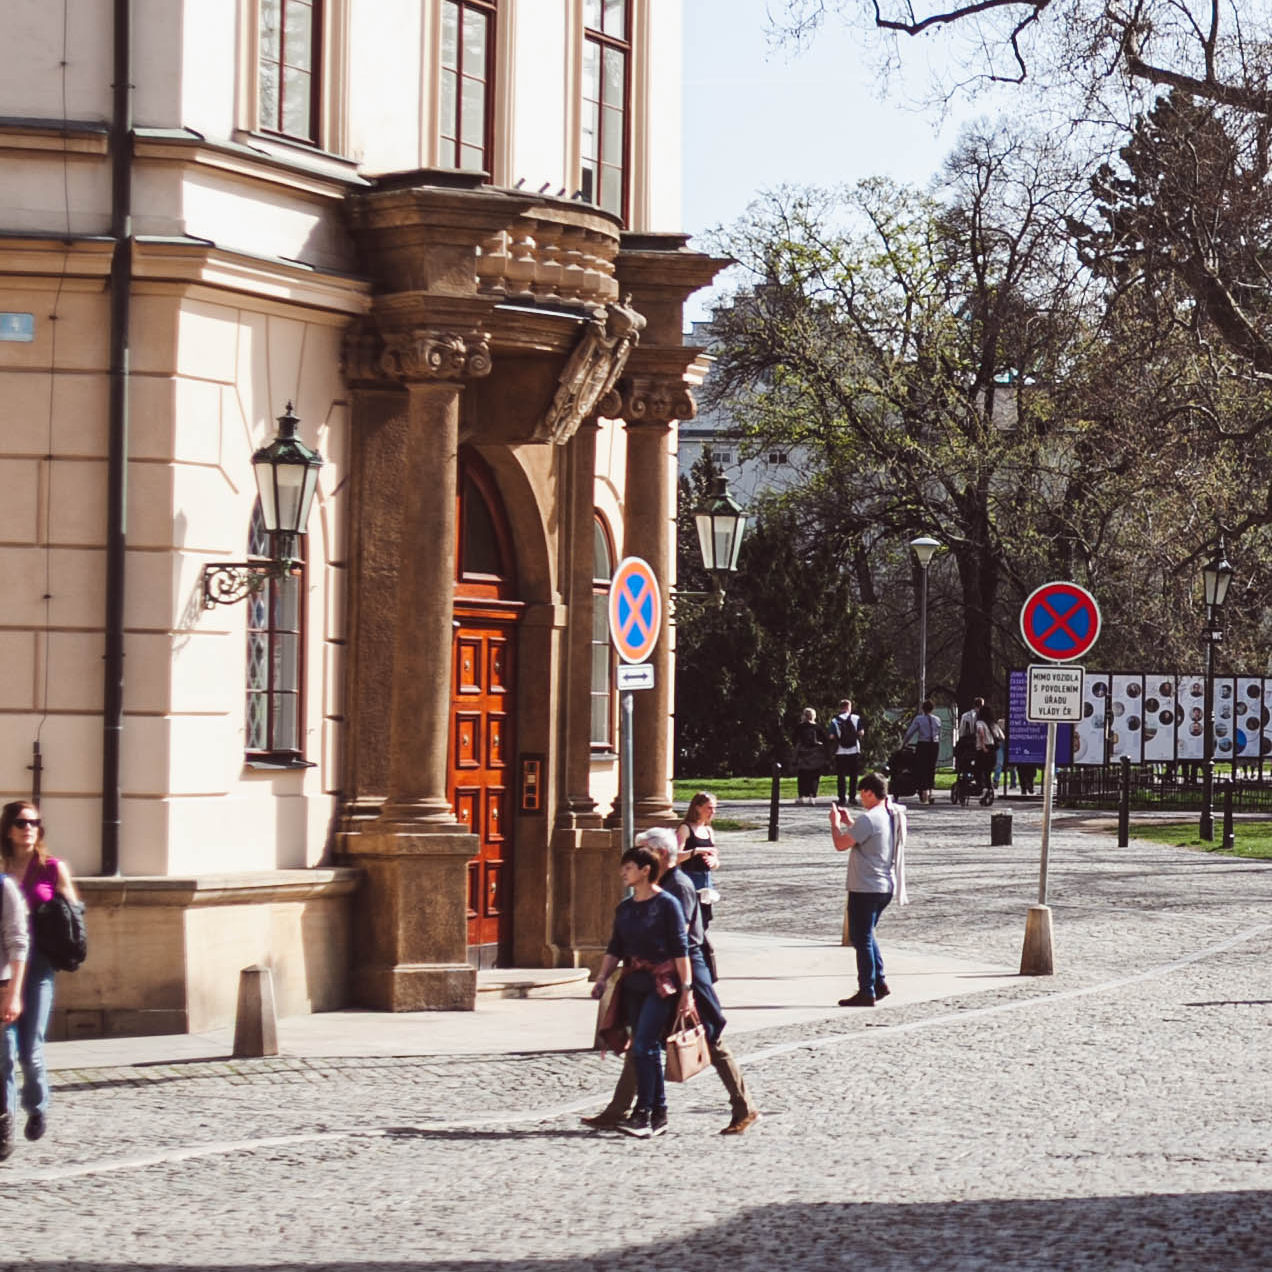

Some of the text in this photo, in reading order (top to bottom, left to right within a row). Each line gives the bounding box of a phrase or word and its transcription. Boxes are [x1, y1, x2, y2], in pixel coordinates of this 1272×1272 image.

[1212, 631, 1223, 640] WC
[1033, 673, 1051, 682] MIMO
[1052, 673, 1079, 682] VOZIDLA
[1033, 684, 1079, 693] S POVOLENÍM
[1044, 694, 1067, 704] ÚŘADU
[1039, 705, 1072, 716] VLÁDY ČR
